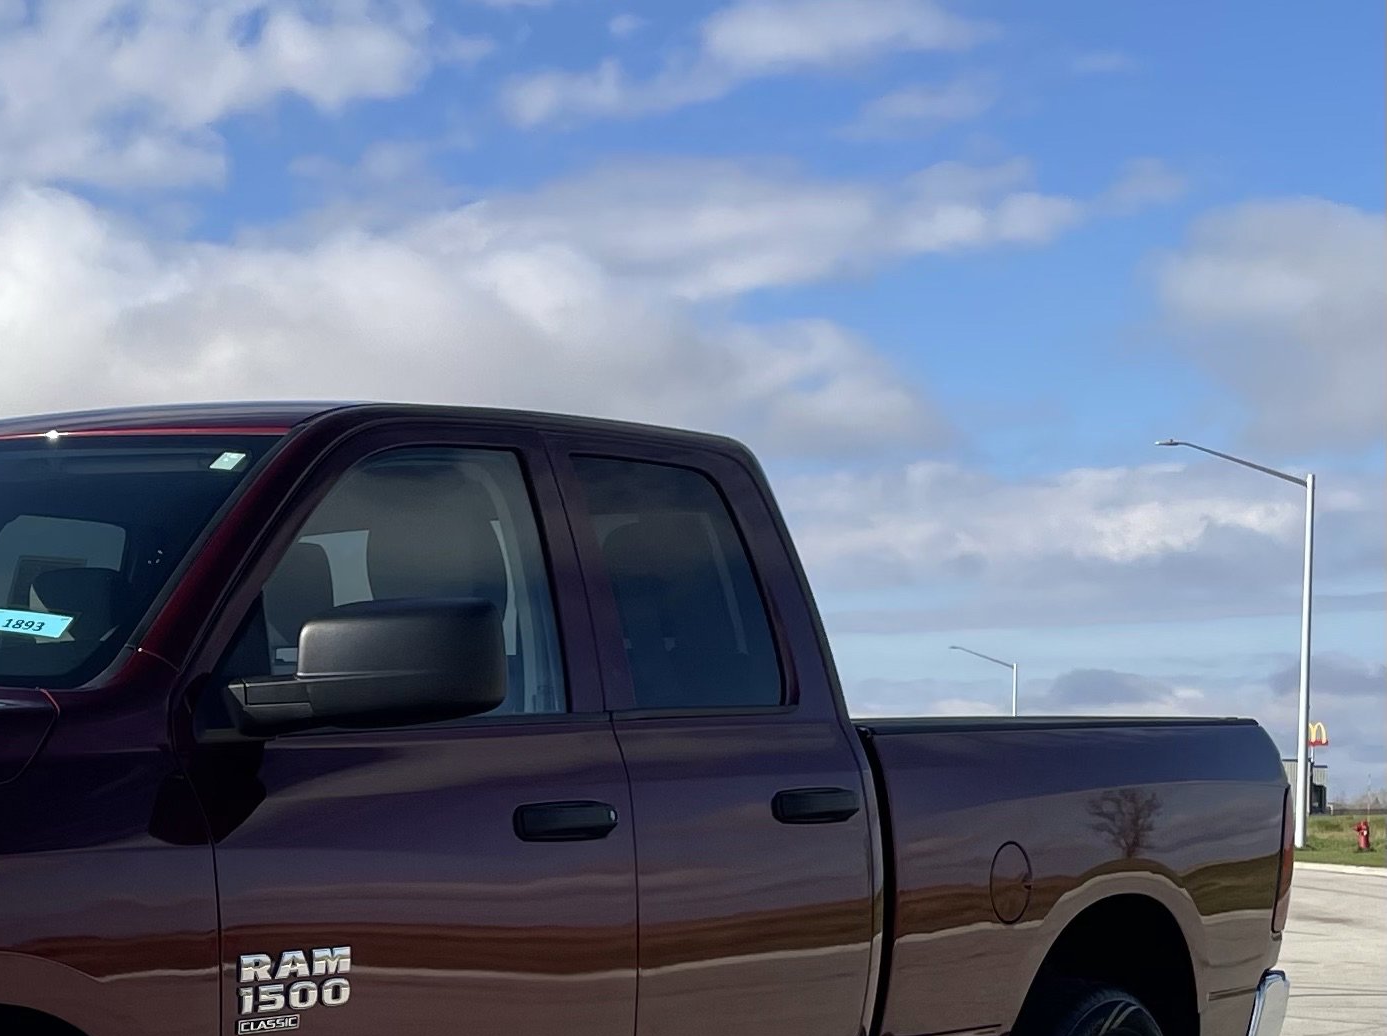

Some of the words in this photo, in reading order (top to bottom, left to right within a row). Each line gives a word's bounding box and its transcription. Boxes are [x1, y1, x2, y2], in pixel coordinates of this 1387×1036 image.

[2, 618, 45, 632] 1893
[239, 946, 351, 982] RAM
[239, 978, 351, 1015] 1500
[240, 1016, 298, 1032] CLASSIC
